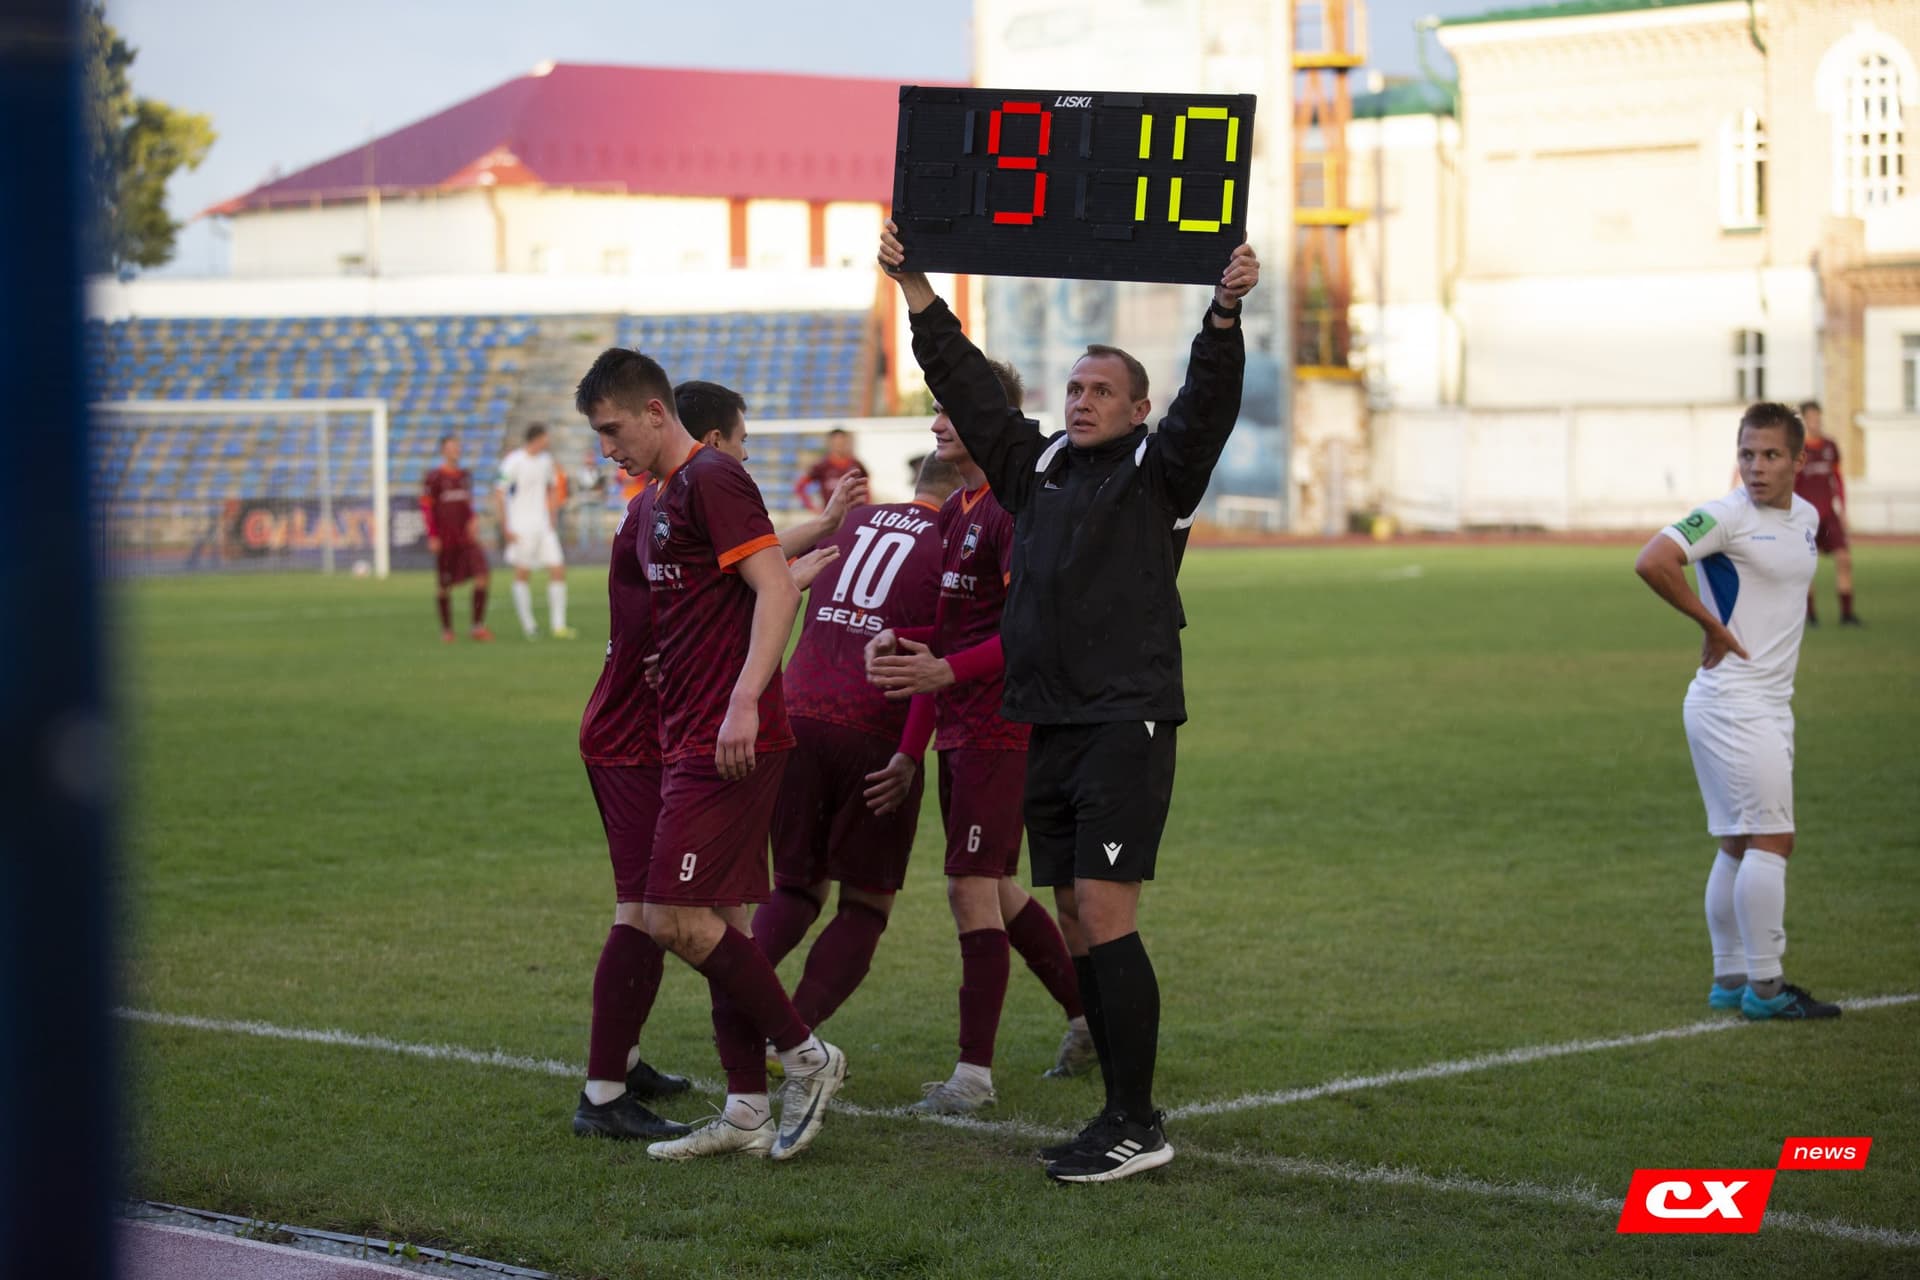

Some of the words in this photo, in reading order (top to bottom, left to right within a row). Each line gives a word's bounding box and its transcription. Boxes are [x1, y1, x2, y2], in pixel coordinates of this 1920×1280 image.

[1054, 96, 1092, 109] LISKI
[987, 101, 1052, 225] 9
[1134, 106, 1240, 232] 10
[870, 509, 935, 535] ЦВЫК
[831, 525, 916, 610] 10
[815, 606, 885, 632] SEUS
[966, 824, 982, 853] 6
[679, 852, 698, 882] 9
